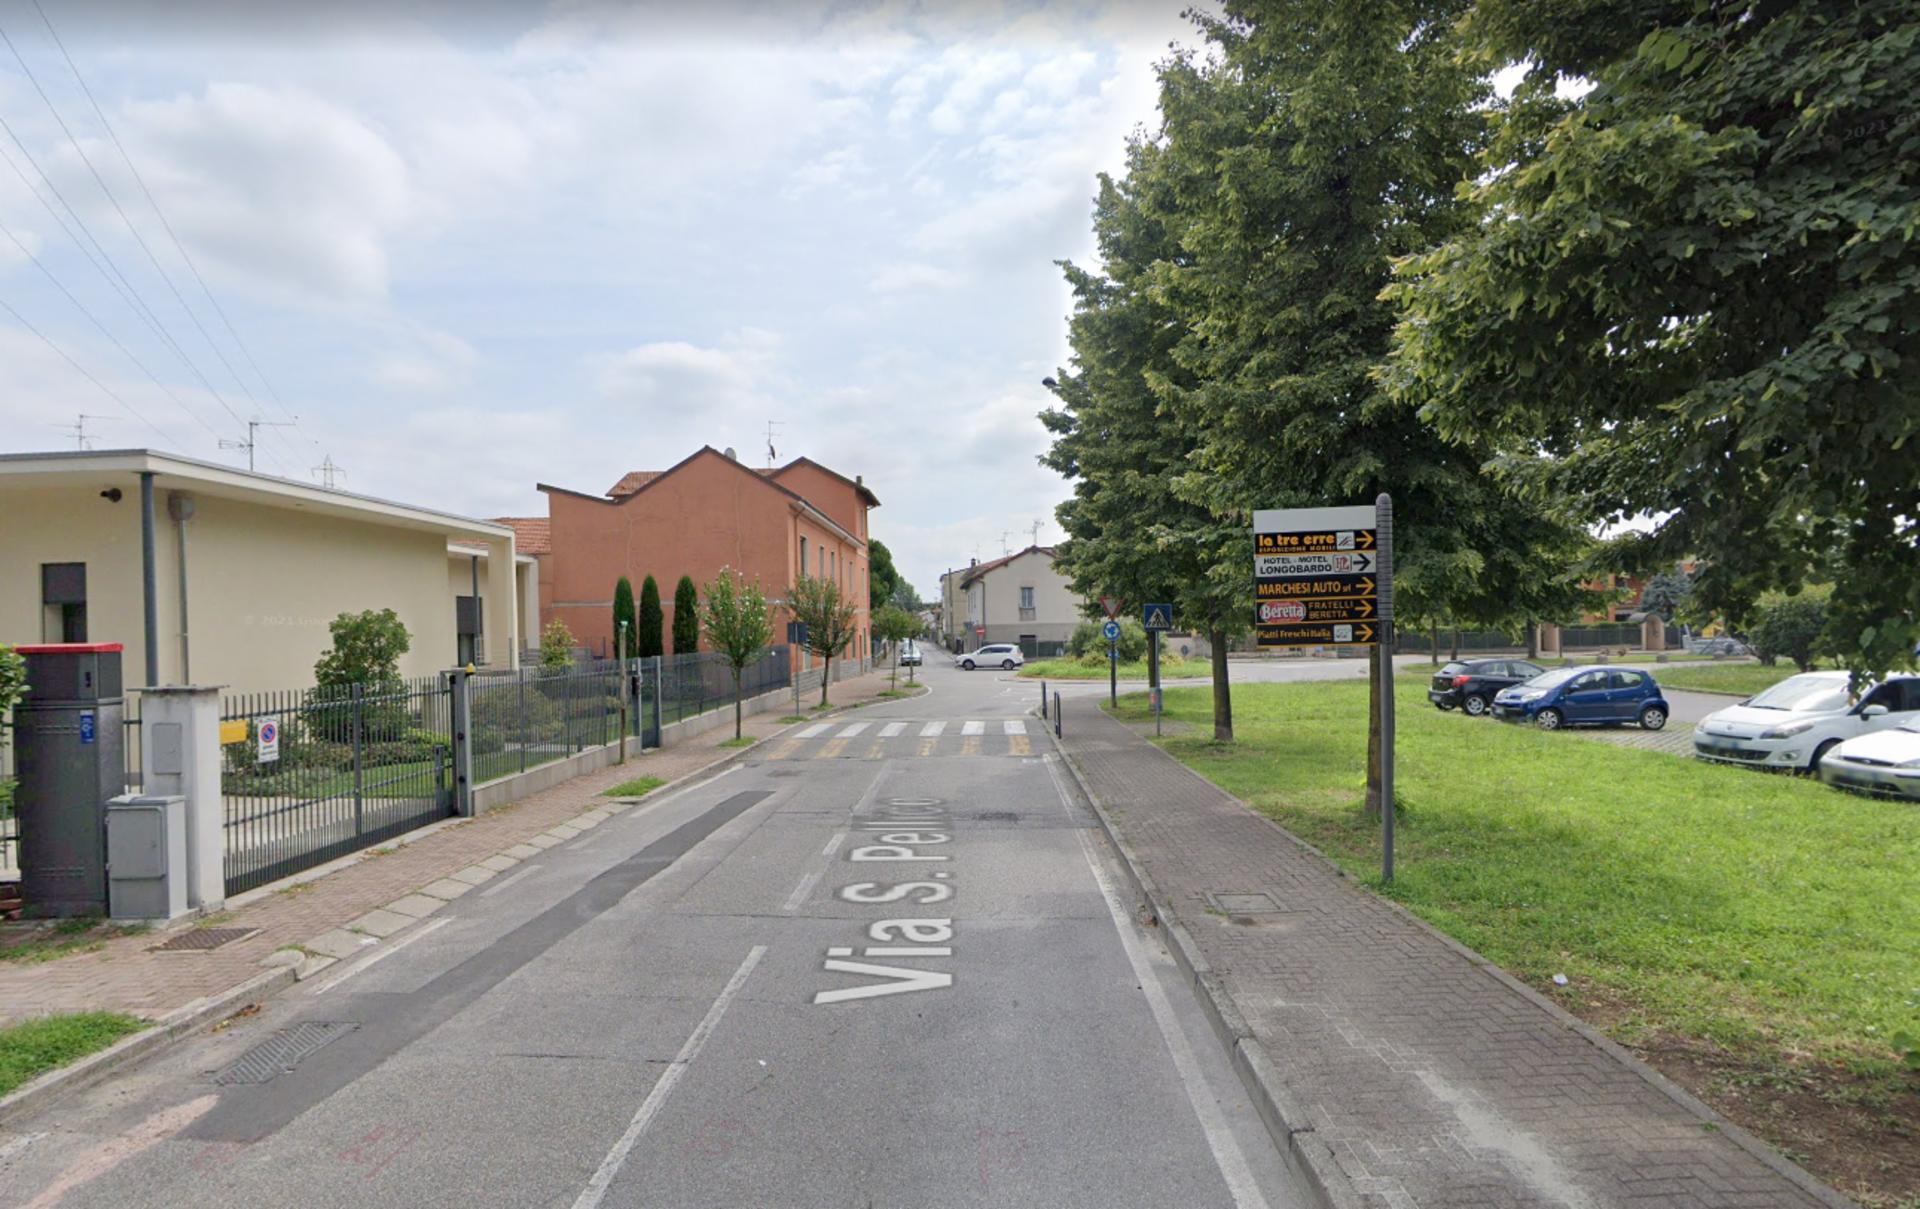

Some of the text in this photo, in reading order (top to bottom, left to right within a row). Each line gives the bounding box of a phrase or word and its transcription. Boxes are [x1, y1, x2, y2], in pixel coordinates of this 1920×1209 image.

[1259, 534, 1335, 546] la tre erre
[1260, 564, 1332, 574] LONGOBARDO
[1258, 582, 1311, 595] MARCHESI
[1313, 581, 1341, 593] AUTO
[1308, 601, 1354, 609] FRATELLI
[1261, 603, 1305, 619] Beretta
[1308, 609, 1349, 619] BERETTA
[1280, 629, 1309, 639] Freschi
